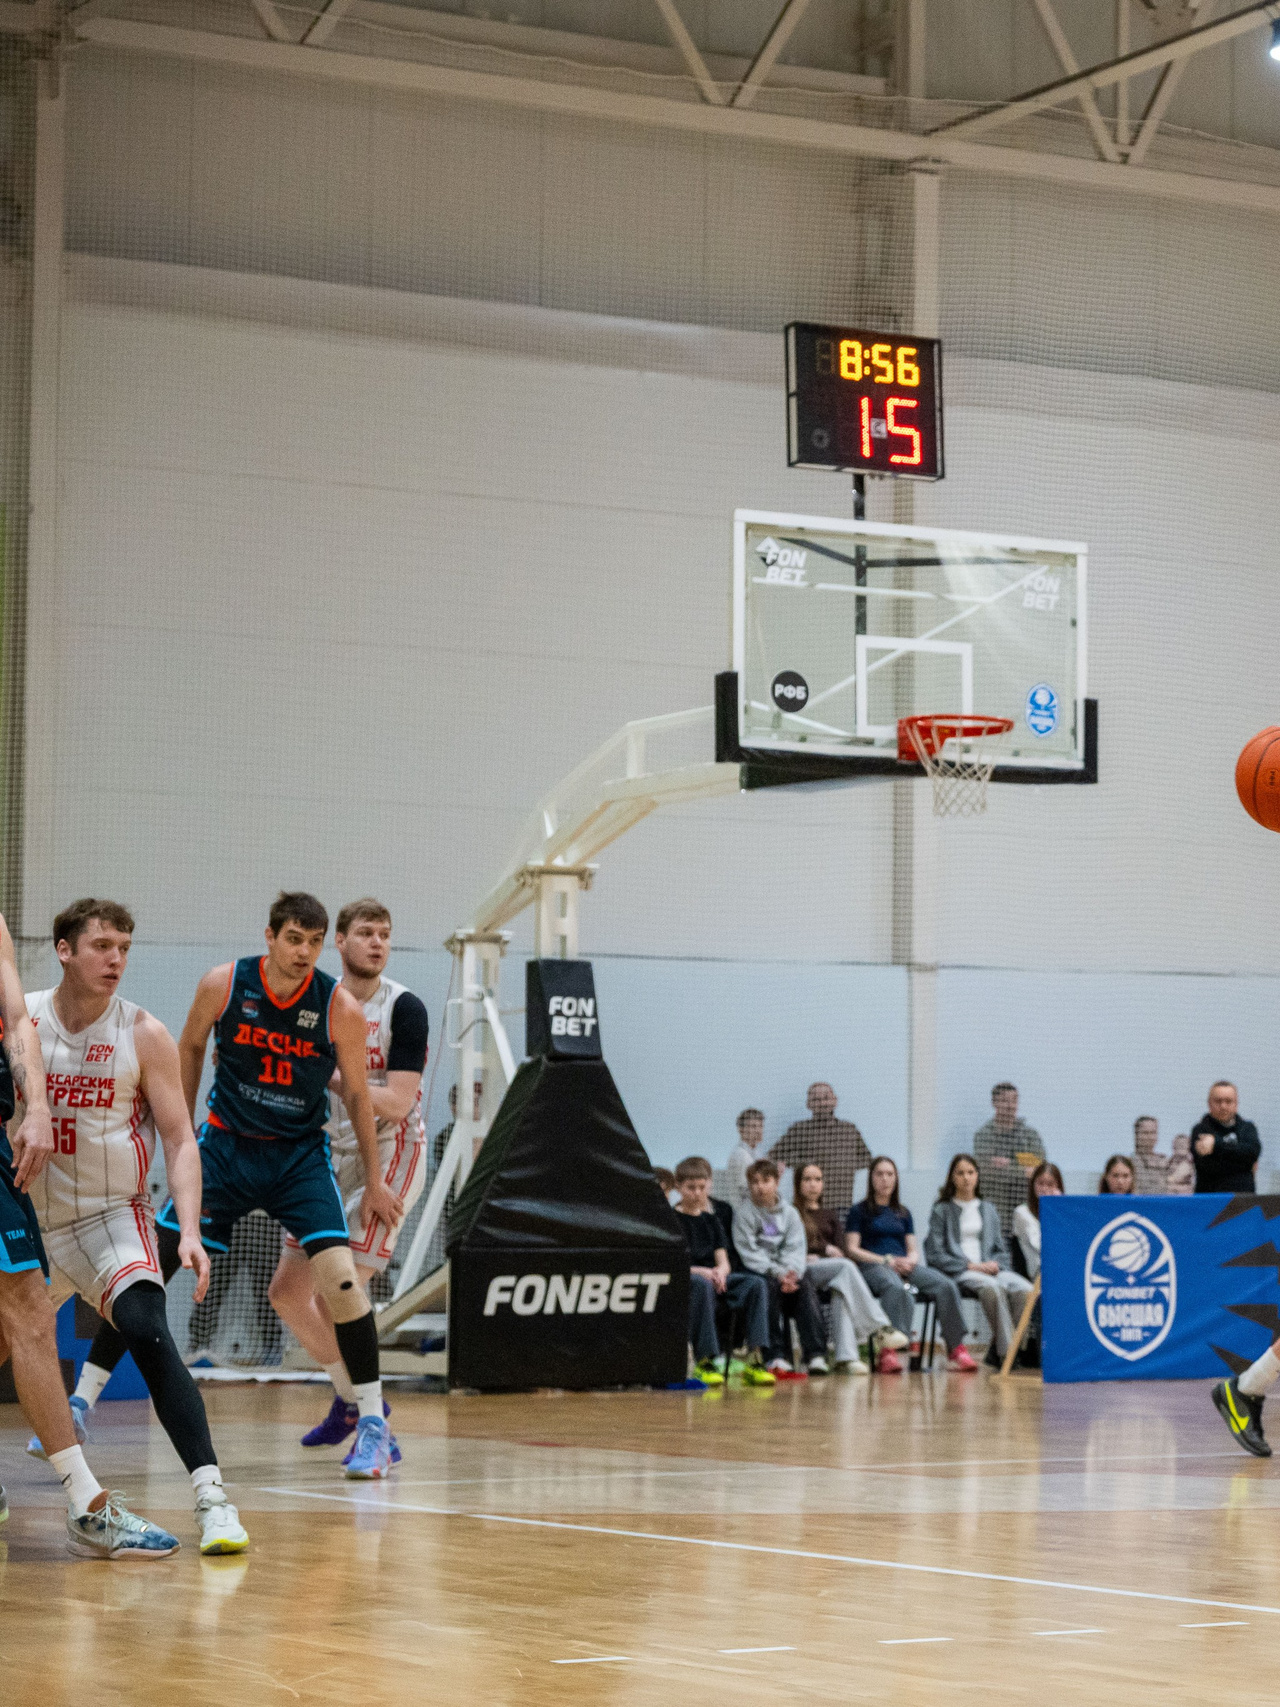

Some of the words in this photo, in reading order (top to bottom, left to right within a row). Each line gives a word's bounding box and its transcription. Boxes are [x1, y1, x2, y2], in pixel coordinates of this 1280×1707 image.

[839, 339, 921, 387] 8:56
[861, 396, 922, 465] 15
[766, 549, 806, 568] FON
[765, 566, 806, 583] BET
[1022, 591, 1059, 610] BET
[774, 683, 807, 700] РФБ
[298, 1009, 320, 1021] FON
[548, 996, 596, 1017] FON
[297, 1018, 318, 1029] BET
[551, 1015, 598, 1037] BET
[86, 1053, 111, 1062] BET
[89, 1044, 115, 1054] FON
[258, 1055, 292, 1086] 10
[46, 1073, 116, 1090] КСАРСКИЕ
[46, 1085, 116, 1109] ТРЕБЫ
[5, 1228, 27, 1241] TEAM
[483, 1273, 671, 1316] FONBET
[1106, 1286, 1157, 1300] FONBET
